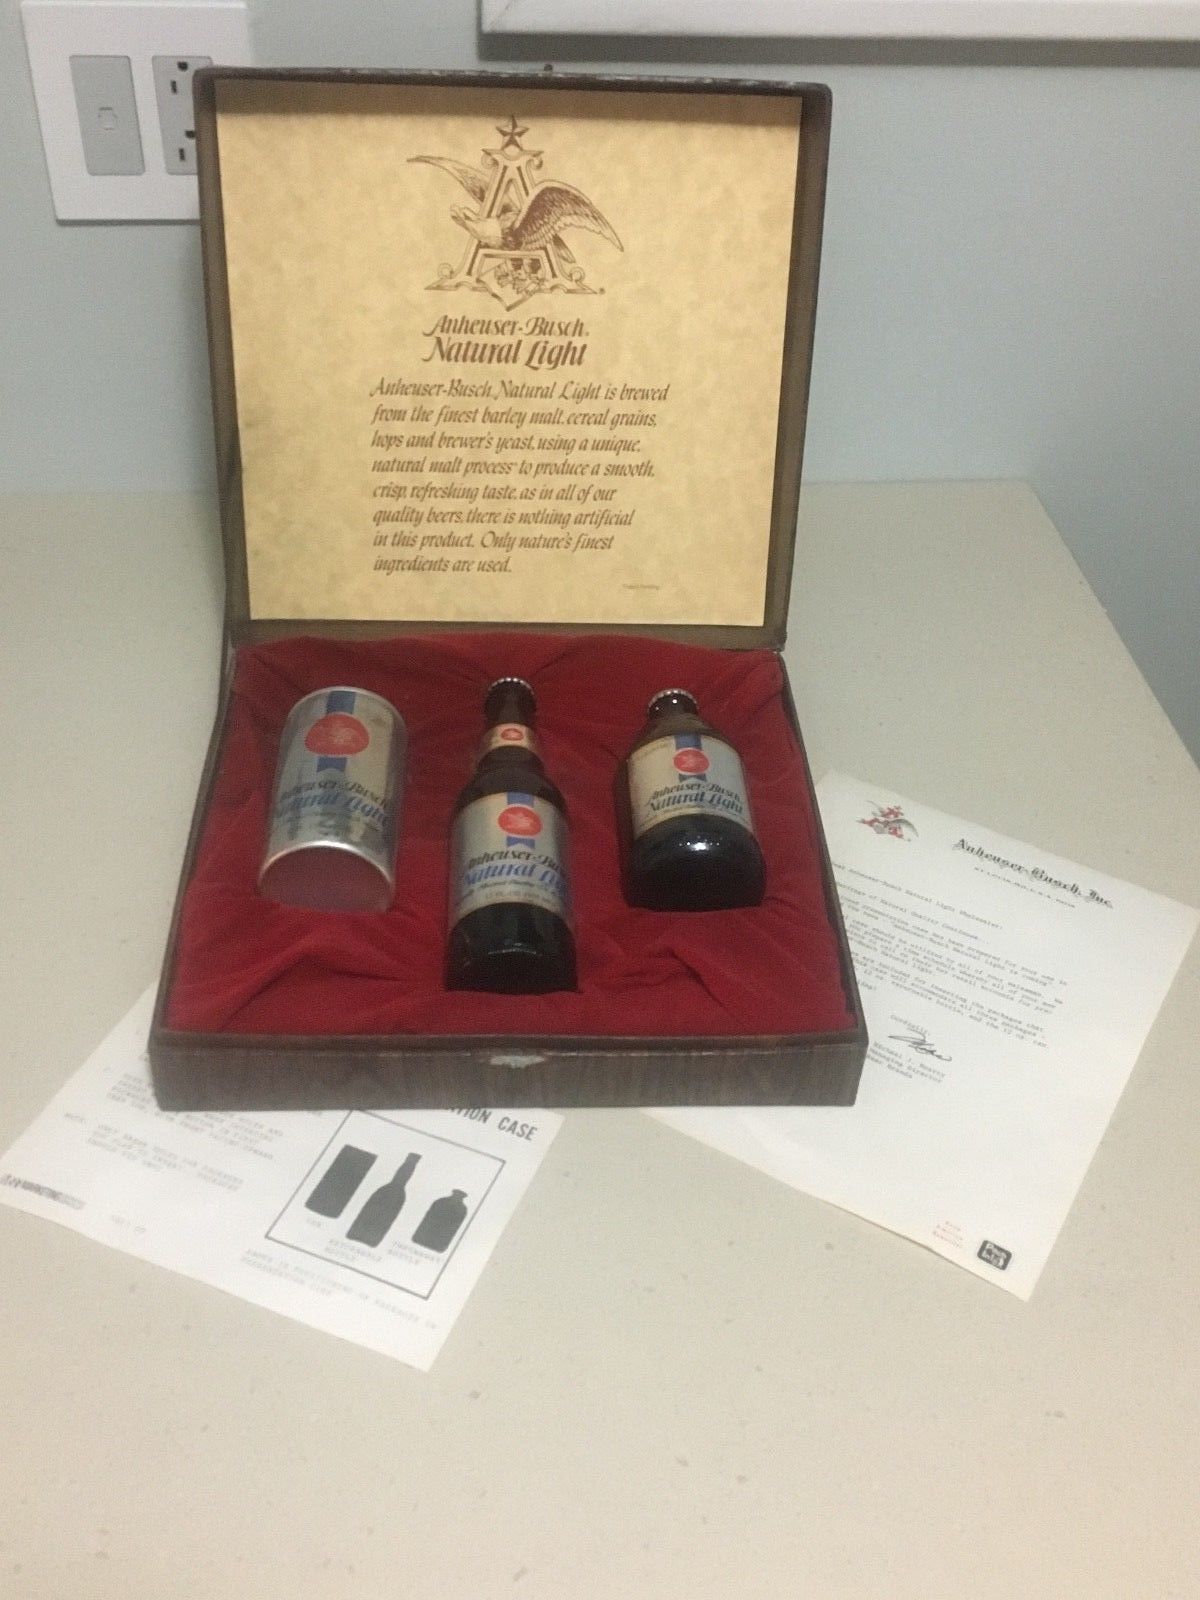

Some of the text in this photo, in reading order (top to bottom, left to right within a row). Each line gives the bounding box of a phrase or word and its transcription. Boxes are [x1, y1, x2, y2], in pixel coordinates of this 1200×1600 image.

[422, 337, 587, 370] Natural Light
[493, 379, 556, 400] Natural
[559, 380, 602, 404] Light
[604, 385, 616, 400] is
[619, 383, 670, 401] brewed
[371, 404, 406, 425] from
[411, 404, 434, 422] the
[435, 405, 479, 426] finest
[481, 406, 526, 428] barley
[371, 430, 403, 449] hops
[406, 431, 434, 448] and
[438, 431, 494, 450] brewer's
[578, 437, 589, 451] a
[372, 457, 427, 473] natural
[429, 457, 462, 474] malt
[518, 459, 532, 475] to
[533, 459, 589, 478] produce
[591, 463, 601, 476] a
[410, 482, 479, 503] refreshing
[538, 485, 553, 501] in
[555, 484, 576, 501] all
[577, 484, 593, 504] of
[593, 488, 617, 501] our
[372, 507, 424, 526] quality
[503, 508, 516, 524] is
[518, 508, 572, 528] nothing
[574, 509, 635, 528] artificial
[373, 531, 615, 552] in this product. Only nature's finest
[373, 555, 512, 575] ingredients are used.
[447, 1107, 538, 1141] ION CASE
